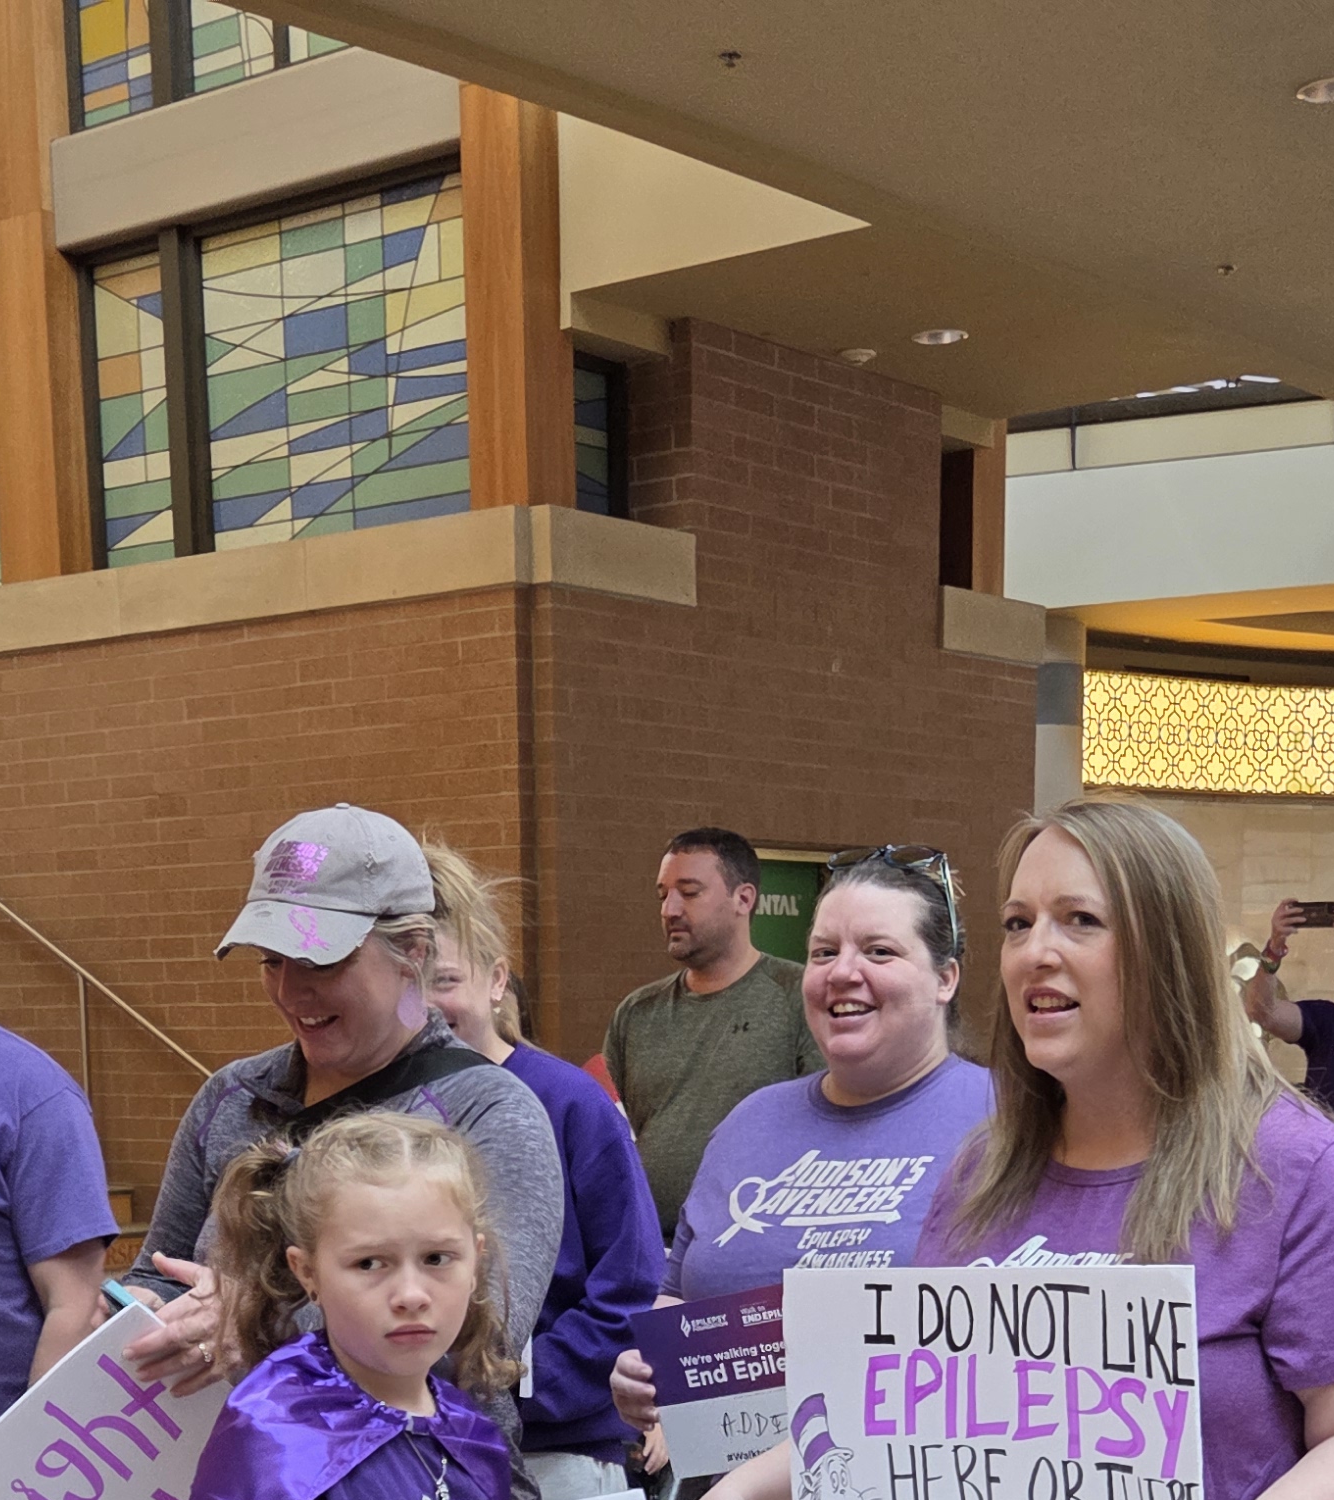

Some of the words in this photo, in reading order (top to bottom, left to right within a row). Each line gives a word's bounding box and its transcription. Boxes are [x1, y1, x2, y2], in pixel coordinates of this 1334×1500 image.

[755, 894, 799, 916] NTAL
[768, 1150, 935, 1188] ADDISON'S
[765, 1185, 914, 1216] AVENGERS
[742, 1313, 762, 1324] END
[864, 1284, 895, 1344] I
[917, 1283, 973, 1353] DO
[989, 1283, 1089, 1366] NOT
[679, 1354, 713, 1367] We're
[714, 1345, 758, 1362] walking
[685, 1363, 728, 1388] End
[864, 1349, 1189, 1479] EPILEPSY
